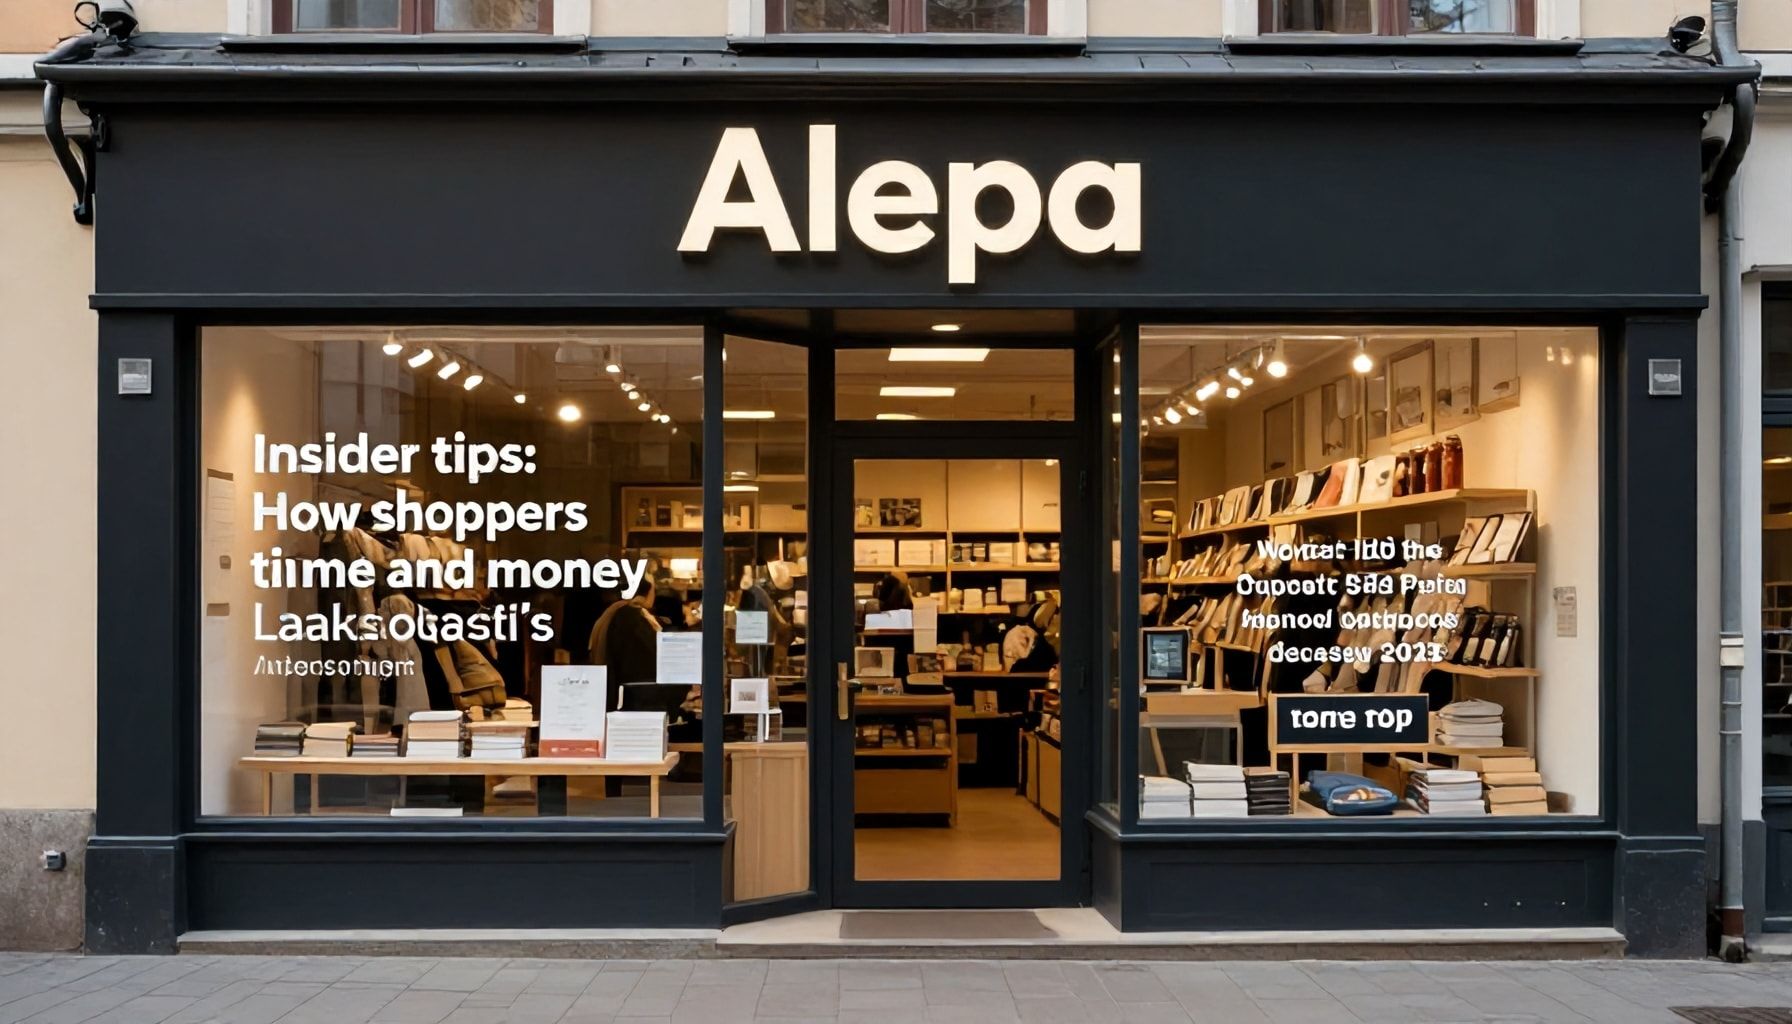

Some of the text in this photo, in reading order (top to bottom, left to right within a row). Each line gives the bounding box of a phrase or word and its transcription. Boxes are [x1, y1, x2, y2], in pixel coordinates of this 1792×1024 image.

[677, 124, 1142, 284] Alepa
[253, 431, 537, 484] Insider tips:
[253, 489, 588, 541] How shoppers
[386, 548, 474, 589] and
[488, 558, 647, 599] money
